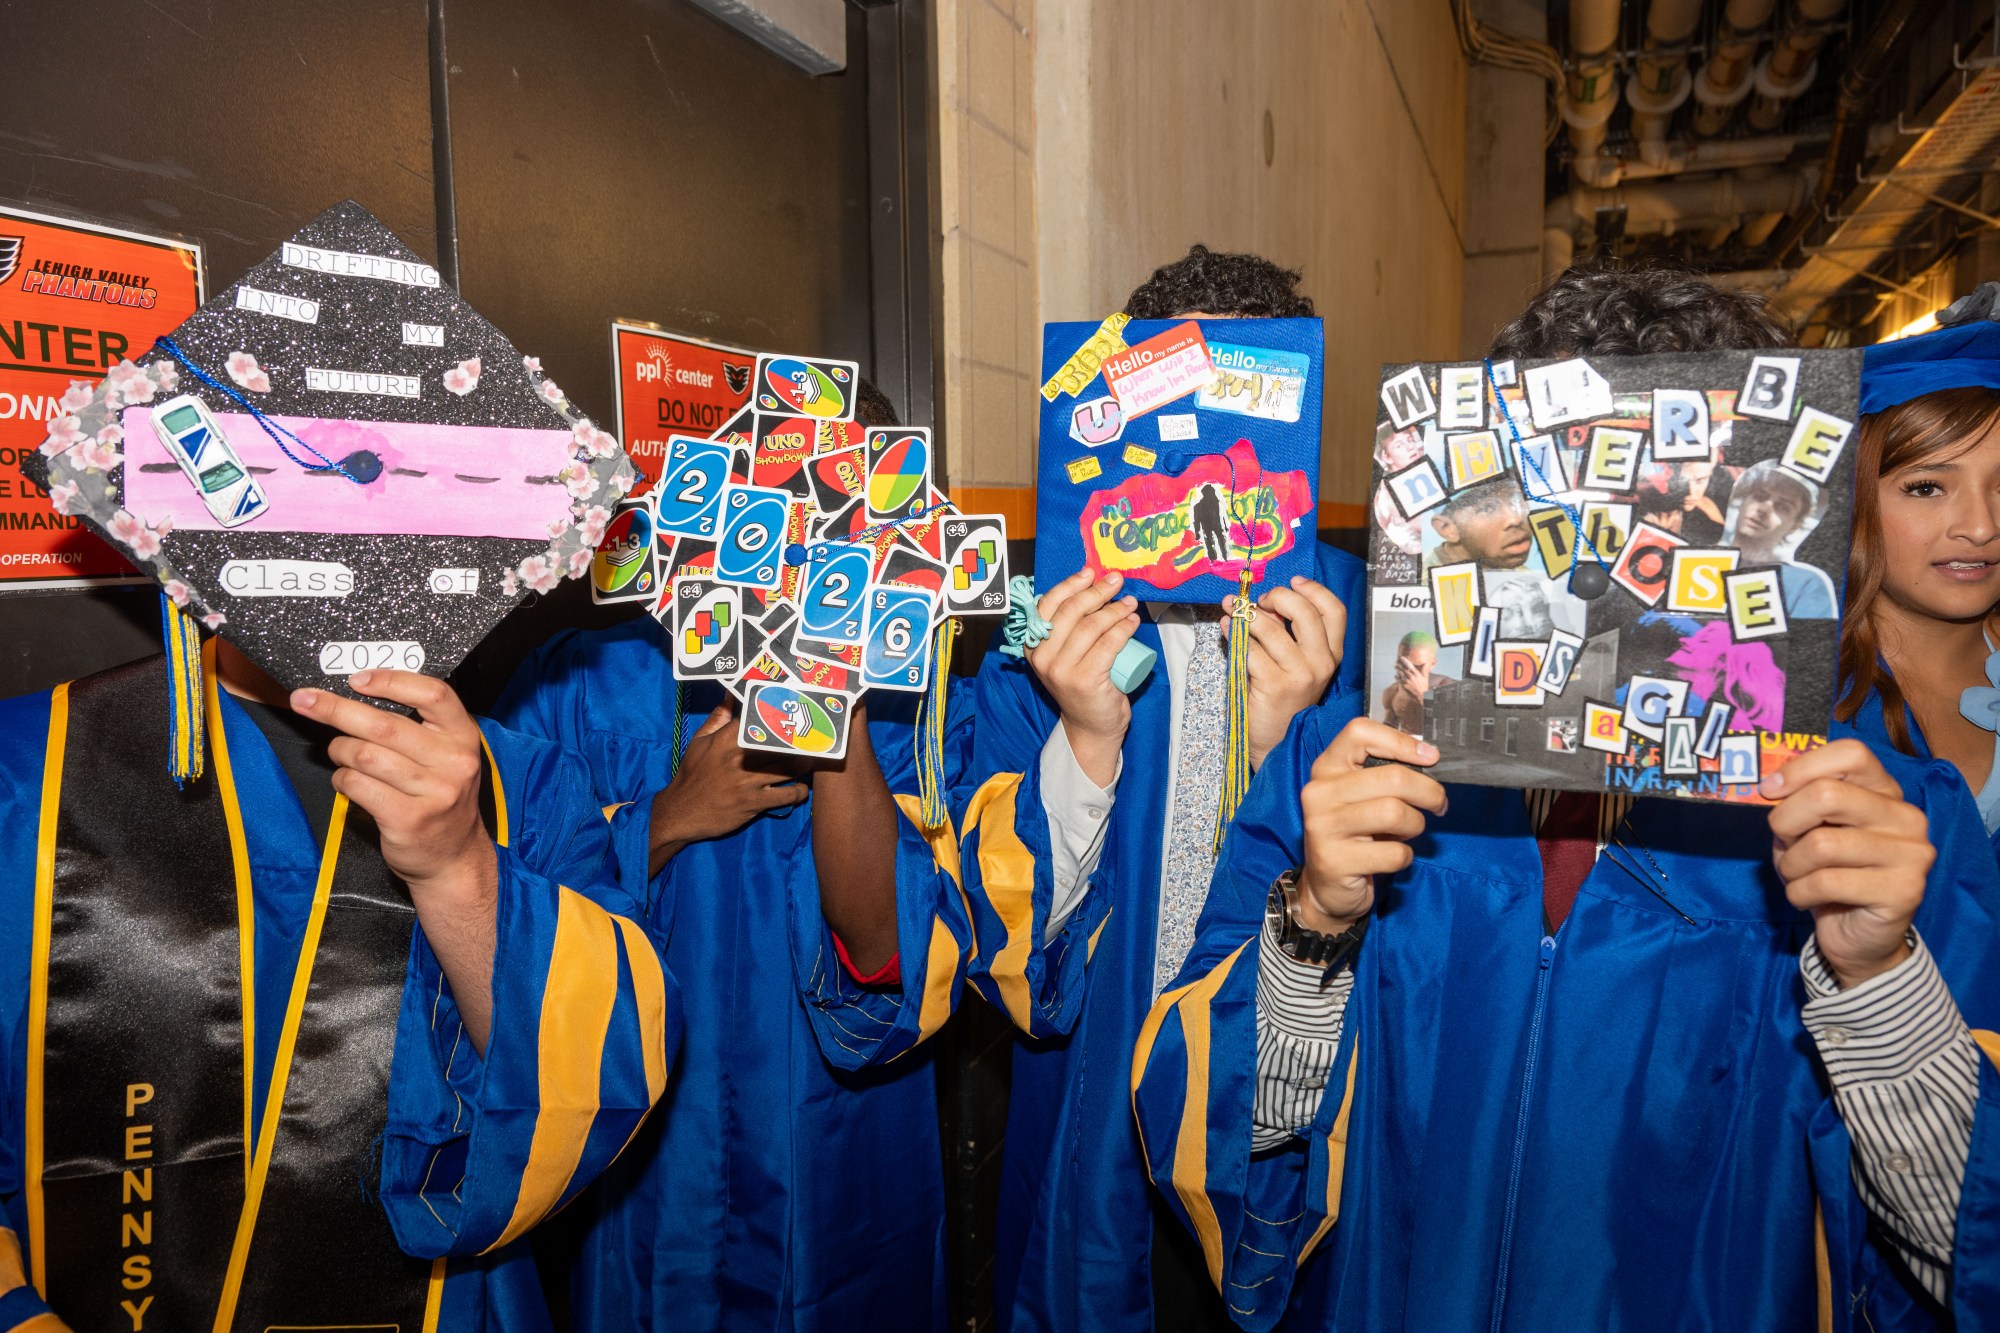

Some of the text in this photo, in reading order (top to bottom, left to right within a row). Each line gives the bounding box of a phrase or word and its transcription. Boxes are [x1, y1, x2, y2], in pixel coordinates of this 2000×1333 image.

[34, 259, 150, 288] LEHIGH VALLEY
[286, 246, 437, 285] DRIFTING
[22, 269, 157, 309] PHANTOMS
[239, 289, 317, 320] INTO
[0, 320, 129, 368] NTER
[404, 325, 438, 344] MY
[636, 357, 714, 388] ppl center
[1106, 350, 1153, 379] Hello
[1154, 350, 1165, 359] my
[1166, 340, 1186, 353] name
[1209, 346, 1256, 369] Hello
[1256, 364, 1268, 372] my
[306, 371, 421, 396] FUTURE
[658, 398, 685, 424] DO
[690, 402, 723, 427] NOT
[673, 443, 688, 459] 2
[764, 432, 806, 451] UNO
[755, 452, 813, 465] SHOWDOW
[676, 469, 709, 505] 2
[699, 517, 715, 532] 2
[788, 502, 799, 545] OWDOWN
[946, 523, 968, 537] +4
[875, 528, 900, 561] WDOWN
[226, 564, 478, 593] Class of
[681, 583, 702, 598] +4
[819, 571, 850, 609] 2
[875, 592, 887, 608] 6
[1231, 598, 1257, 622] 26
[1390, 593, 1433, 609] blon
[845, 620, 859, 637] 2
[884, 617, 912, 656] 6
[325, 645, 421, 670] 2026
[754, 652, 783, 680] UN
[1605, 766, 1634, 788] IN
[120, 1083, 155, 1332] PENNSY
